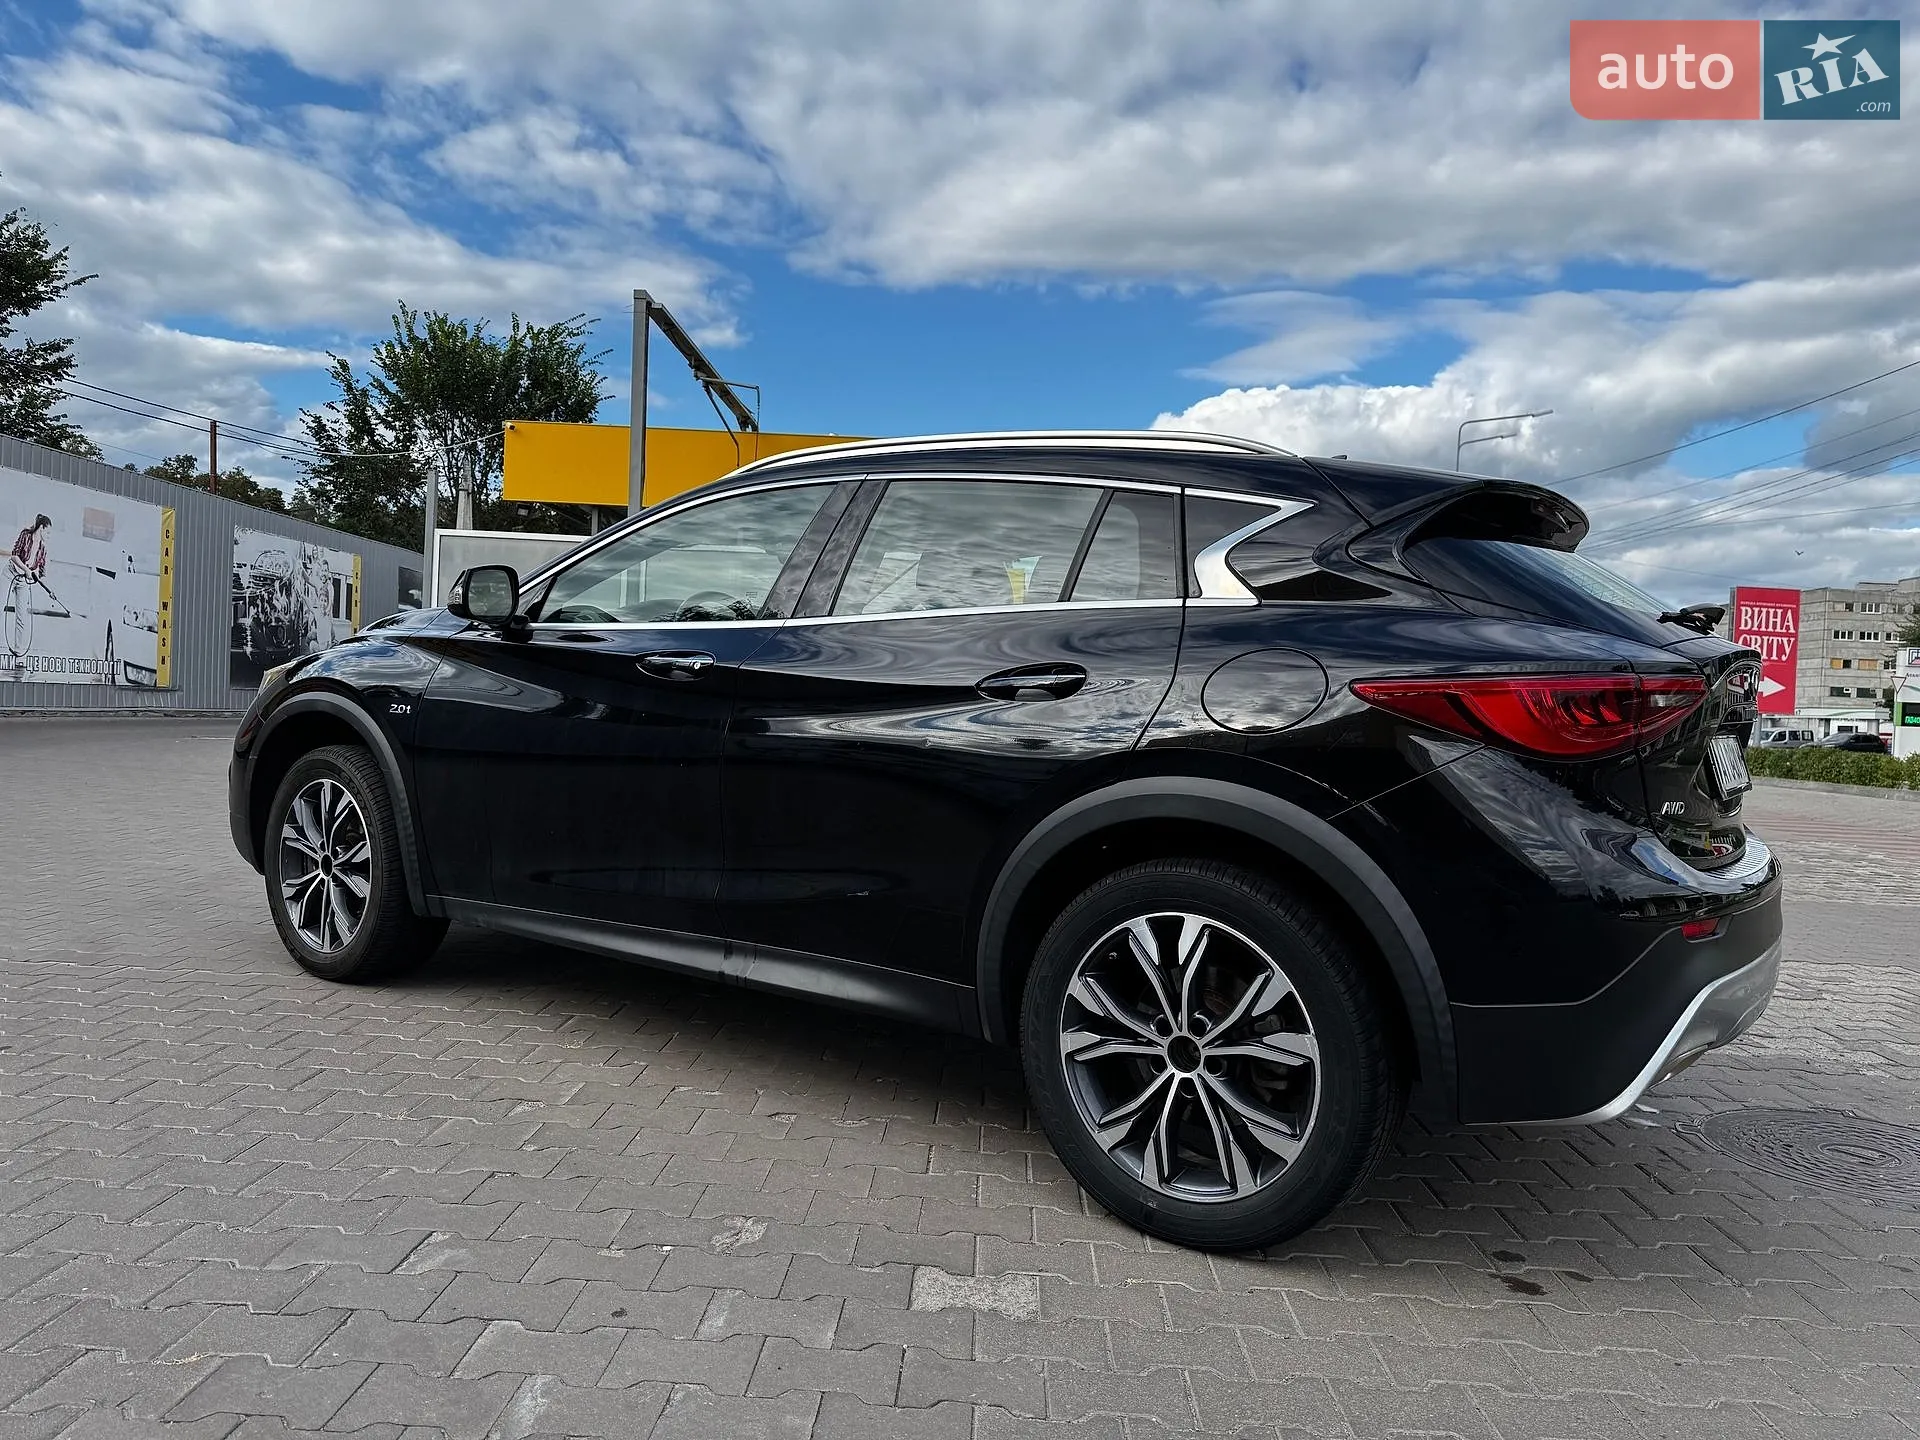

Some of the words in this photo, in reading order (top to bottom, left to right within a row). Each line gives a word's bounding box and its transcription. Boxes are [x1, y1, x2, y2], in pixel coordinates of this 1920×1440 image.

[161, 601, 169, 665] WASH
[1739, 606, 1796, 633] ВИНА
[0, 654, 16, 671] МИ
[26, 656, 39, 674] ЦЕ
[42, 656, 66, 673] НОВІ
[68, 658, 122, 676] ТЕХНОЛОГІЇ
